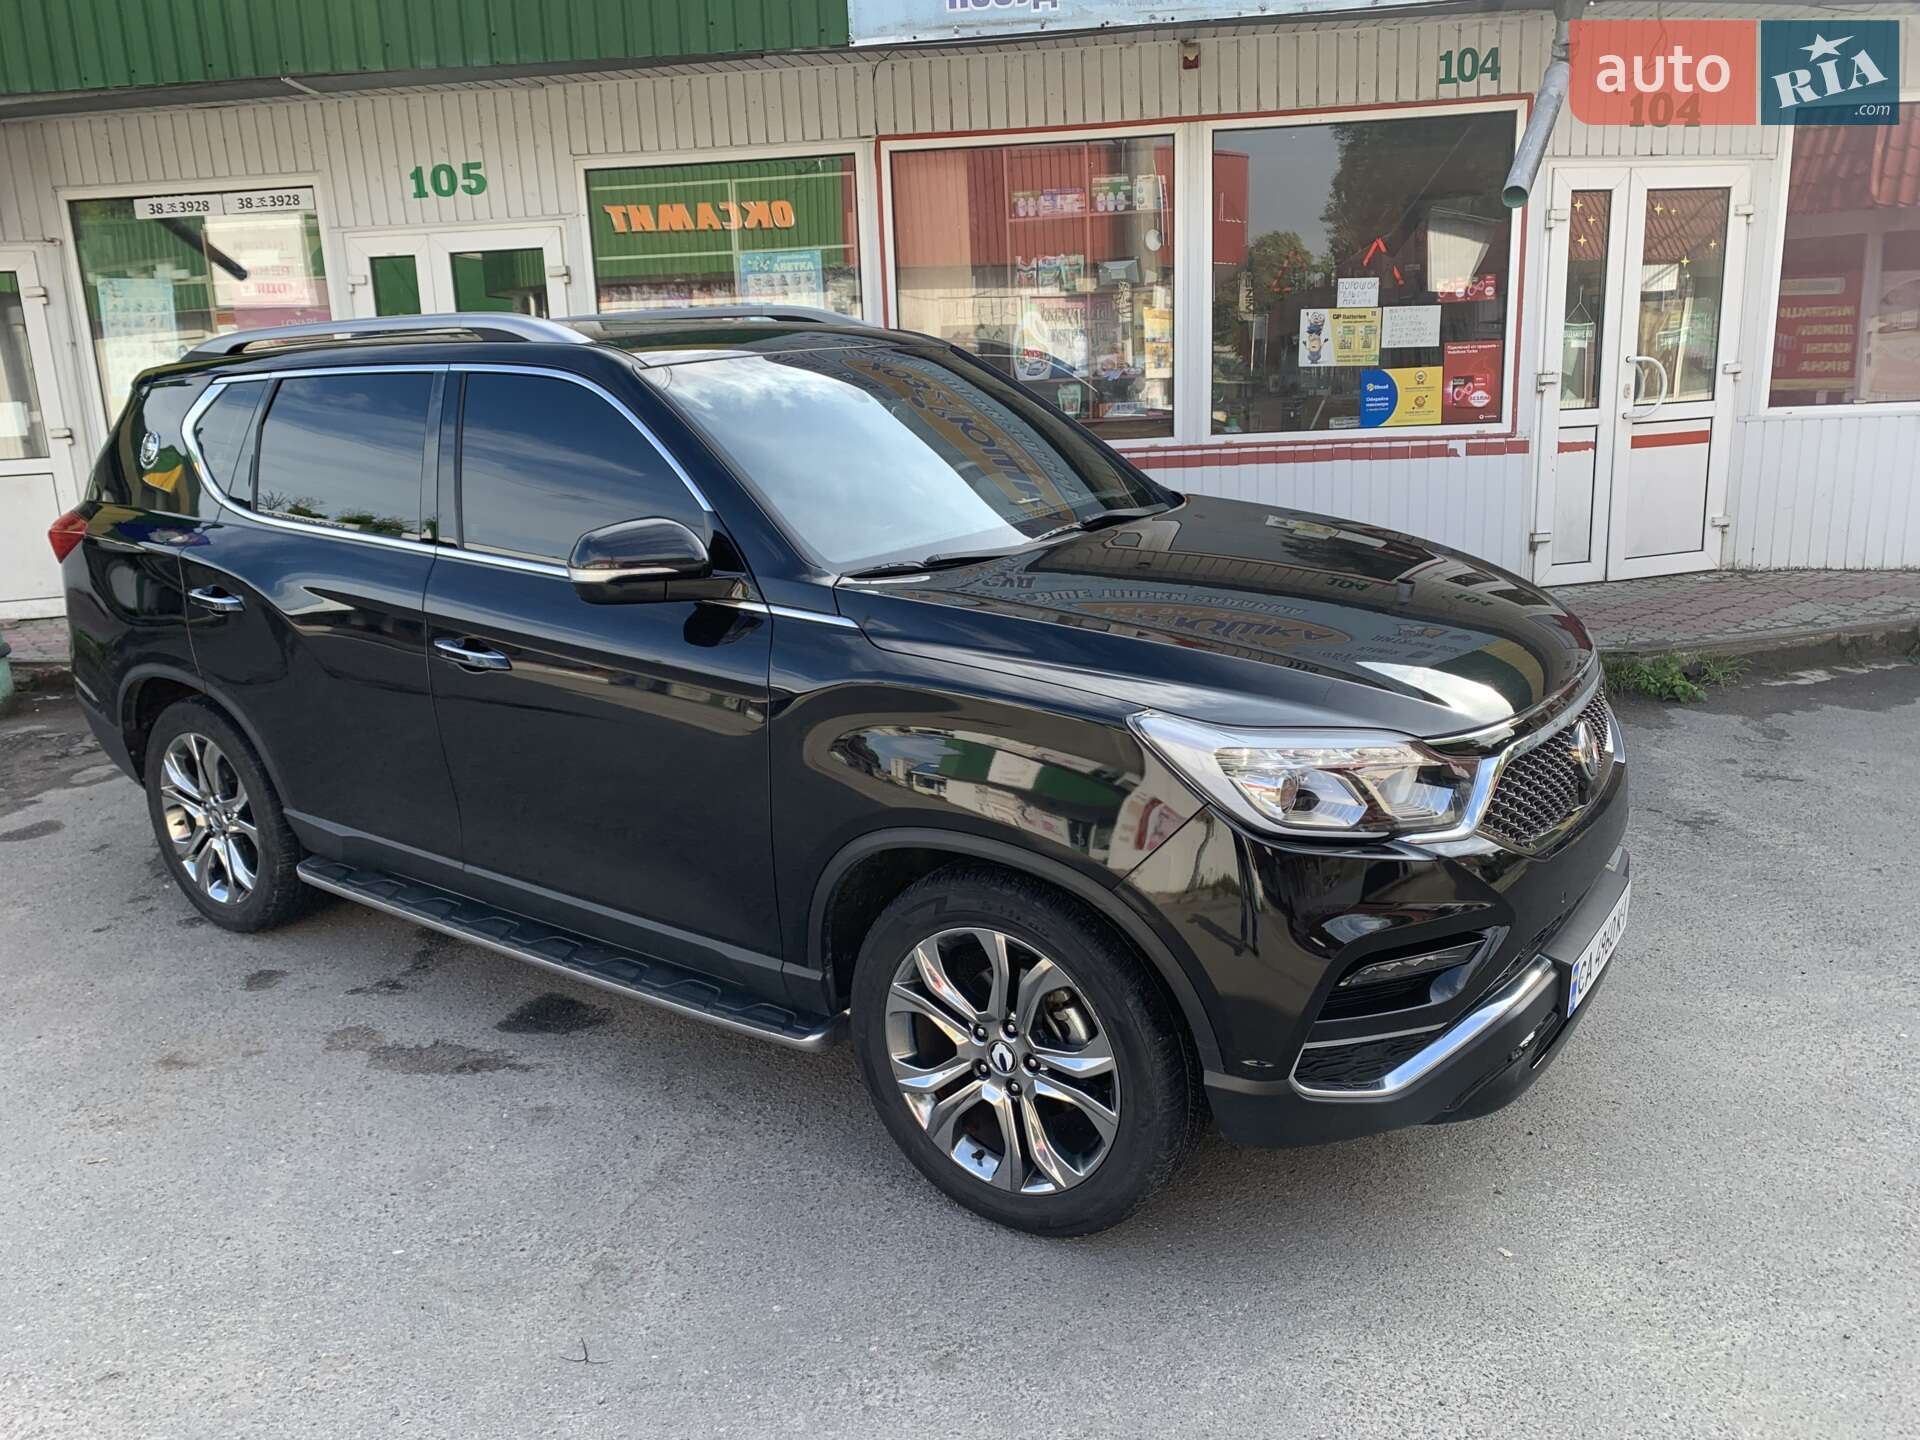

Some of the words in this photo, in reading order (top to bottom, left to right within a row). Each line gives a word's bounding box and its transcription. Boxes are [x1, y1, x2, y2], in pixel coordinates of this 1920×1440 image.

[1438, 47, 1501, 84] 104
[1629, 92, 1701, 127] 104
[409, 162, 488, 198] 105
